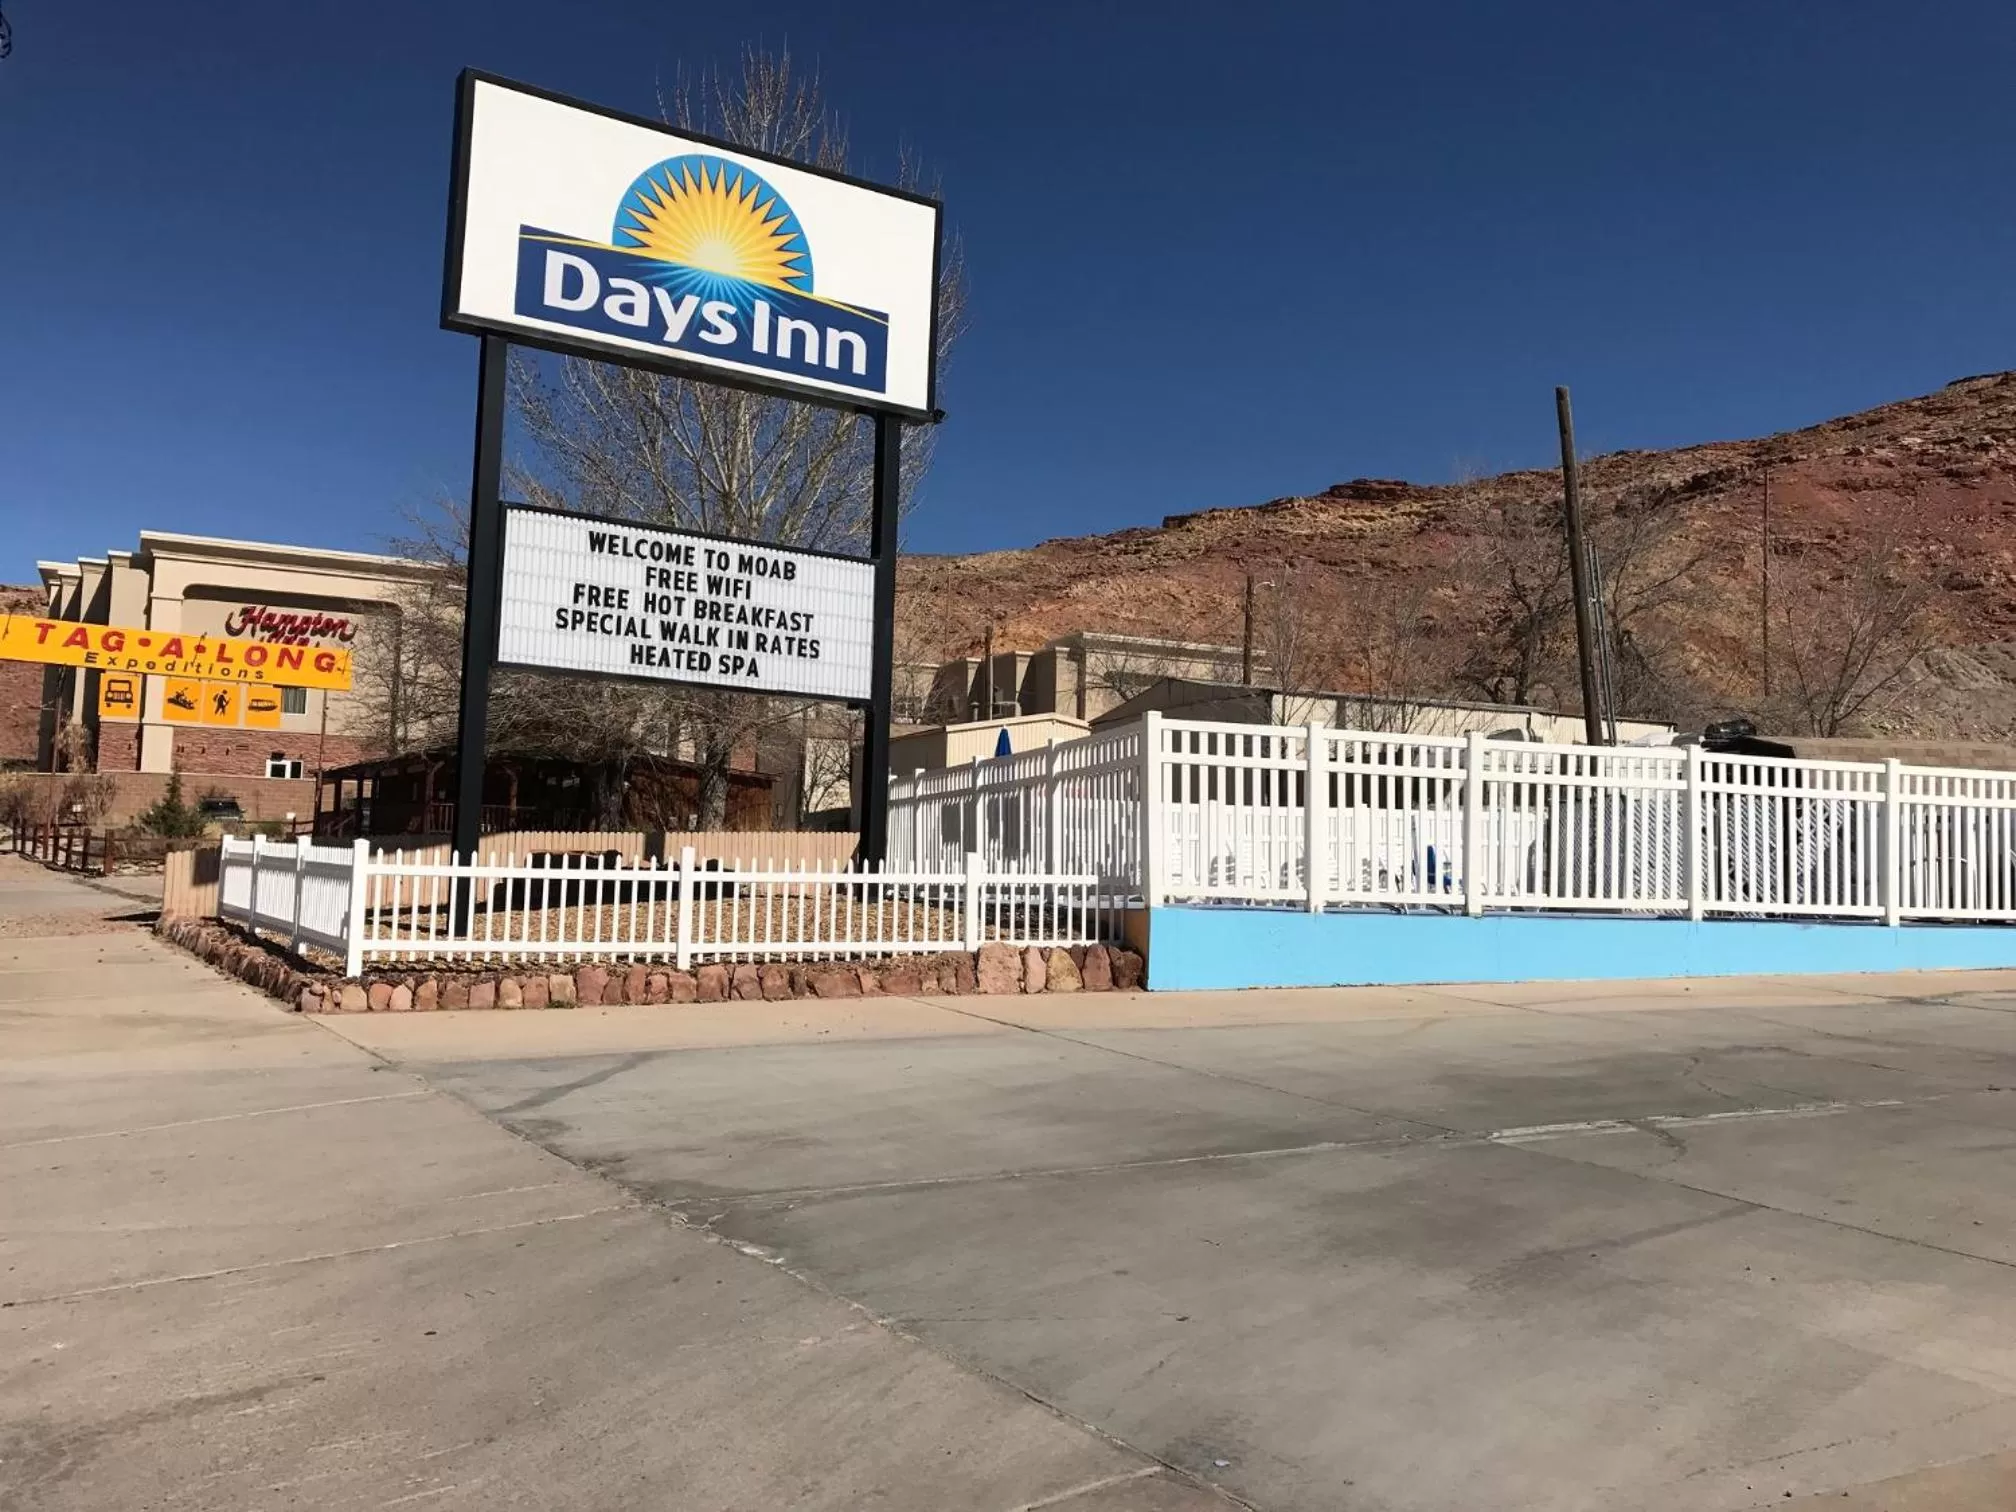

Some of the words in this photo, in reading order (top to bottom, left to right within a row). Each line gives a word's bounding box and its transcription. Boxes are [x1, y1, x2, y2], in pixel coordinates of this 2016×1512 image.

[544, 250, 737, 345] Days
[753, 300, 867, 376] Inn
[589, 531, 695, 566] WELCOME
[704, 549, 730, 571] TO
[738, 555, 796, 581] MOAB
[646, 567, 698, 592] FREE
[707, 575, 752, 599] WIFI
[225, 605, 358, 641] Hampton
[574, 584, 629, 609] FREE
[644, 592, 686, 617] HOT
[694, 600, 814, 633] BREAKFAST
[556, 608, 652, 639] SPECIAL
[660, 620, 719, 647] WALK
[728, 629, 747, 650] IN
[756, 632, 820, 659] RATES
[85, 652, 264, 680] Expeditions
[630, 644, 711, 671] HEATED
[719, 655, 759, 677] SPA
